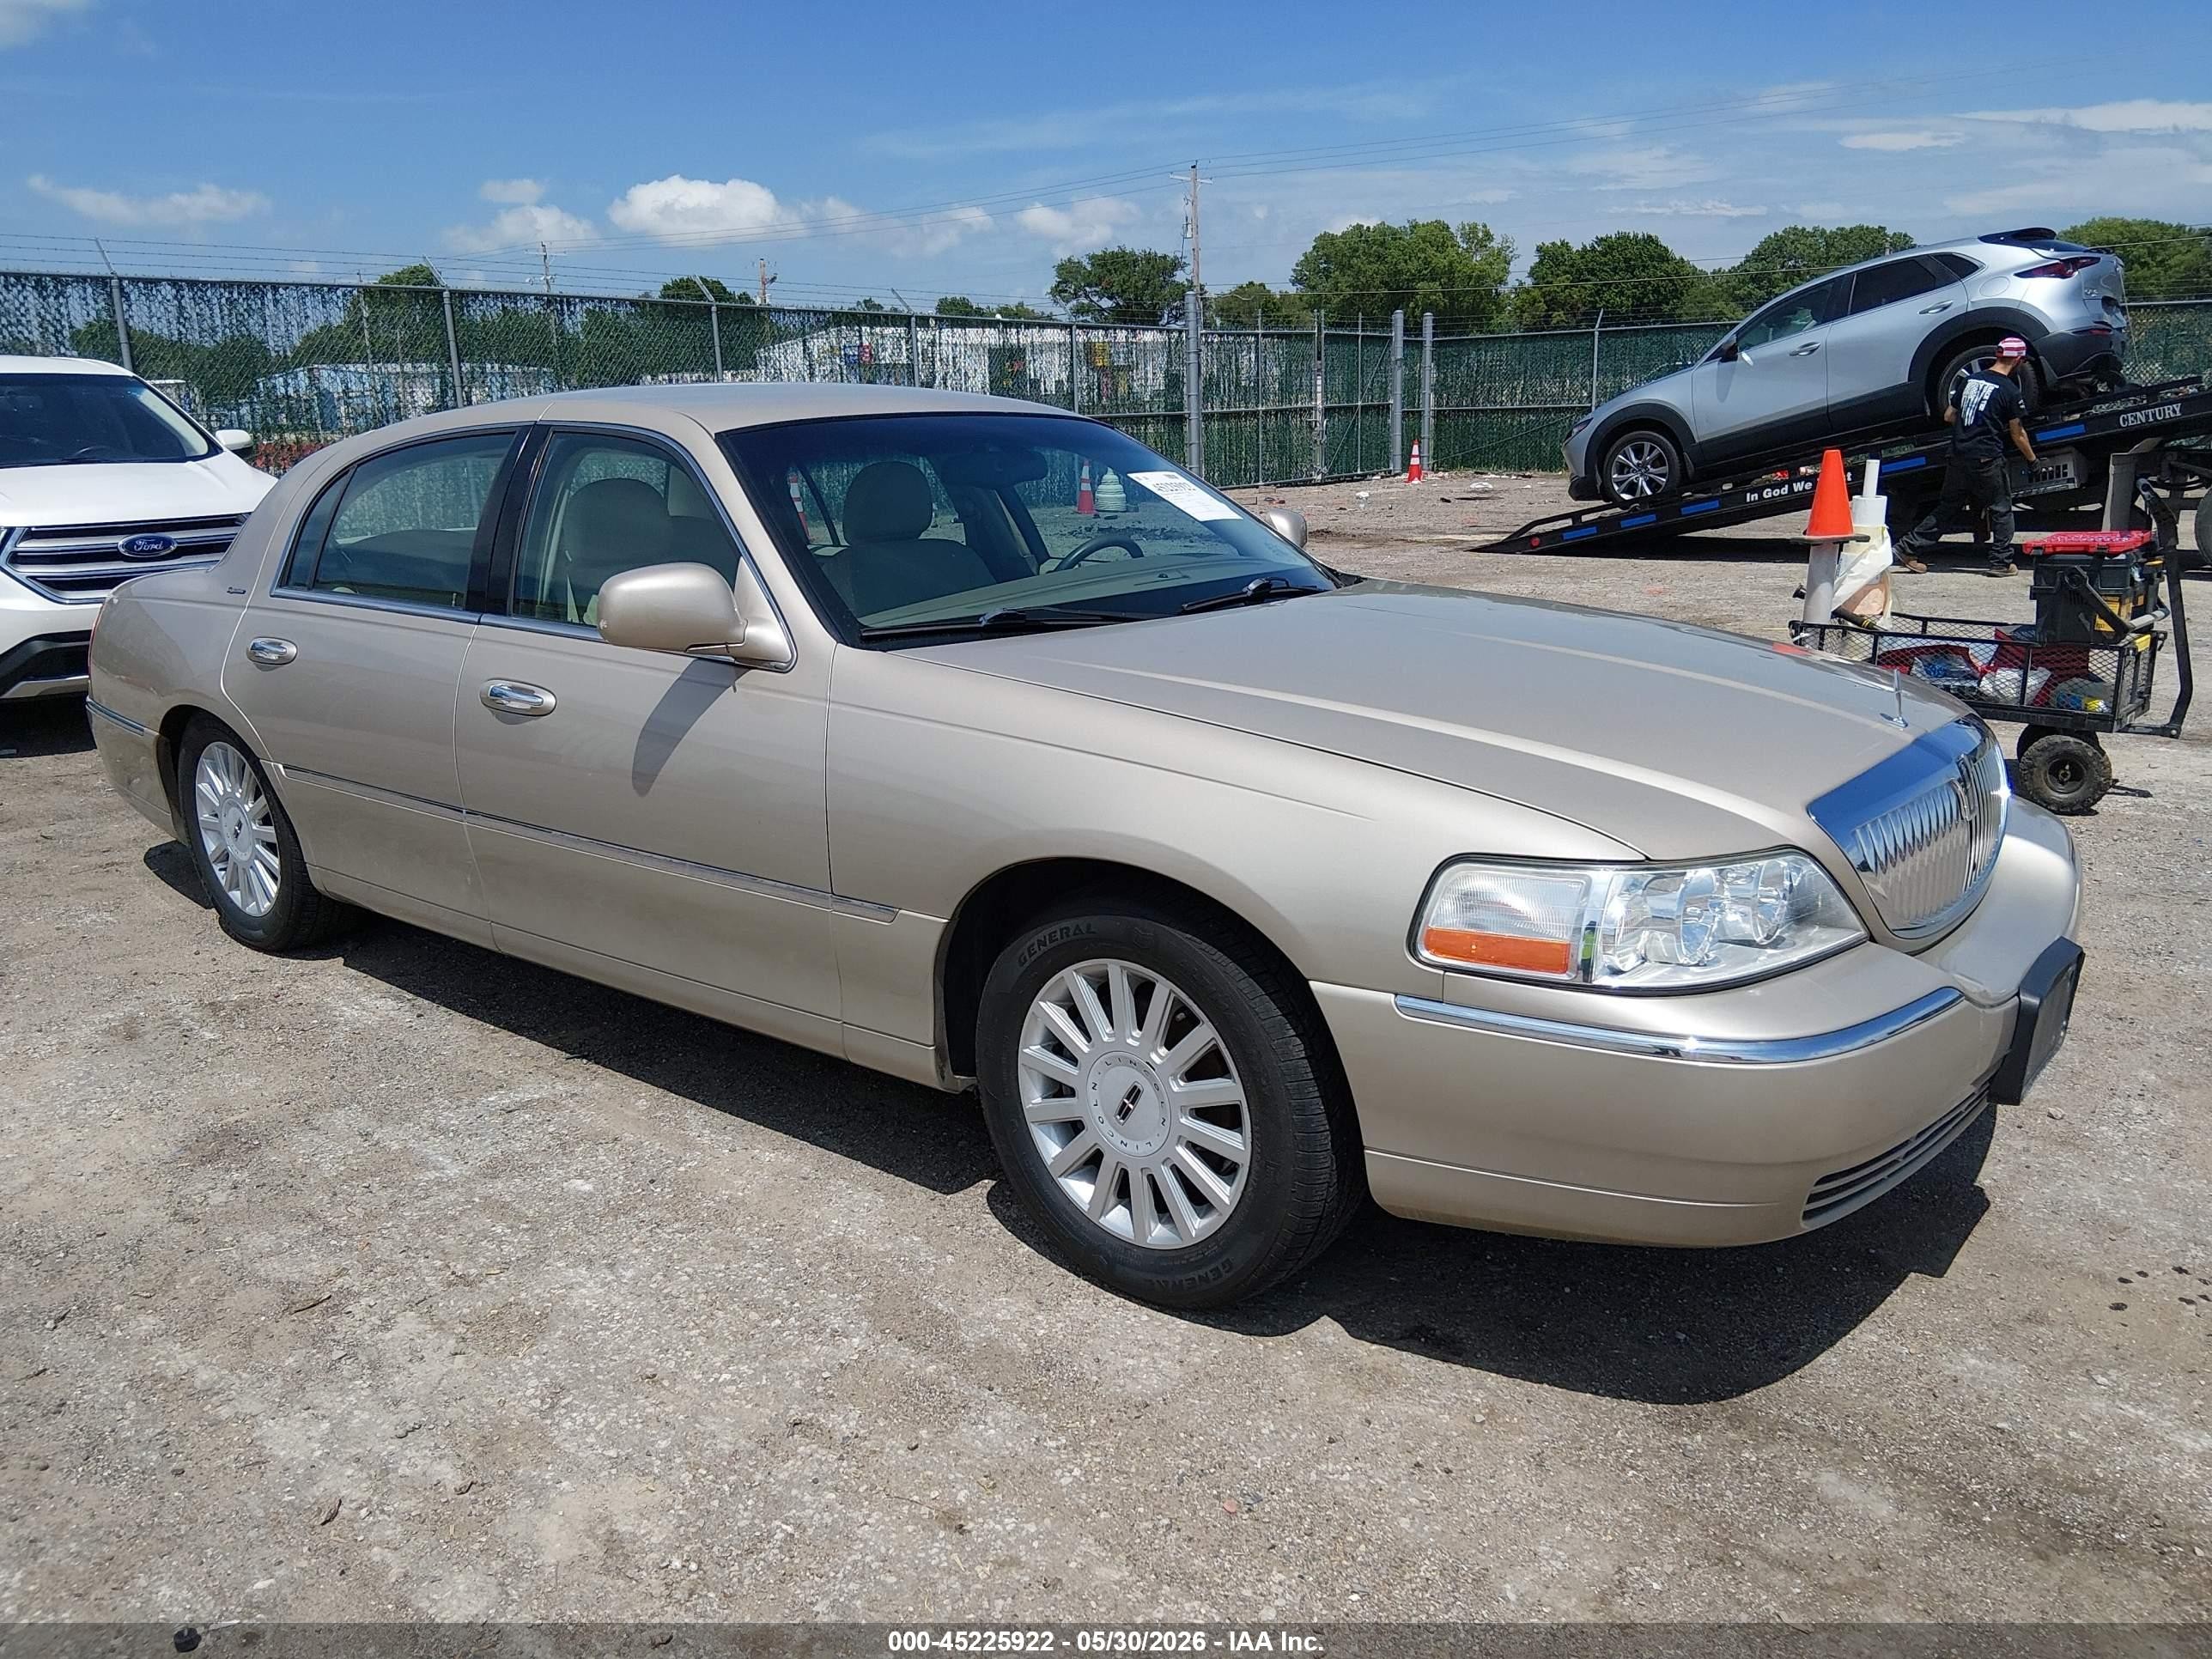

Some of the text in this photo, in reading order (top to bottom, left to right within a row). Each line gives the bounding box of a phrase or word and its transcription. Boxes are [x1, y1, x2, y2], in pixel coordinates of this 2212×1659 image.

[2119, 404, 2182, 428] CENTURY
[1746, 481, 1813, 502] In God We
[134, 539, 164, 551] Ford
[1018, 923, 1097, 967] GENERAL
